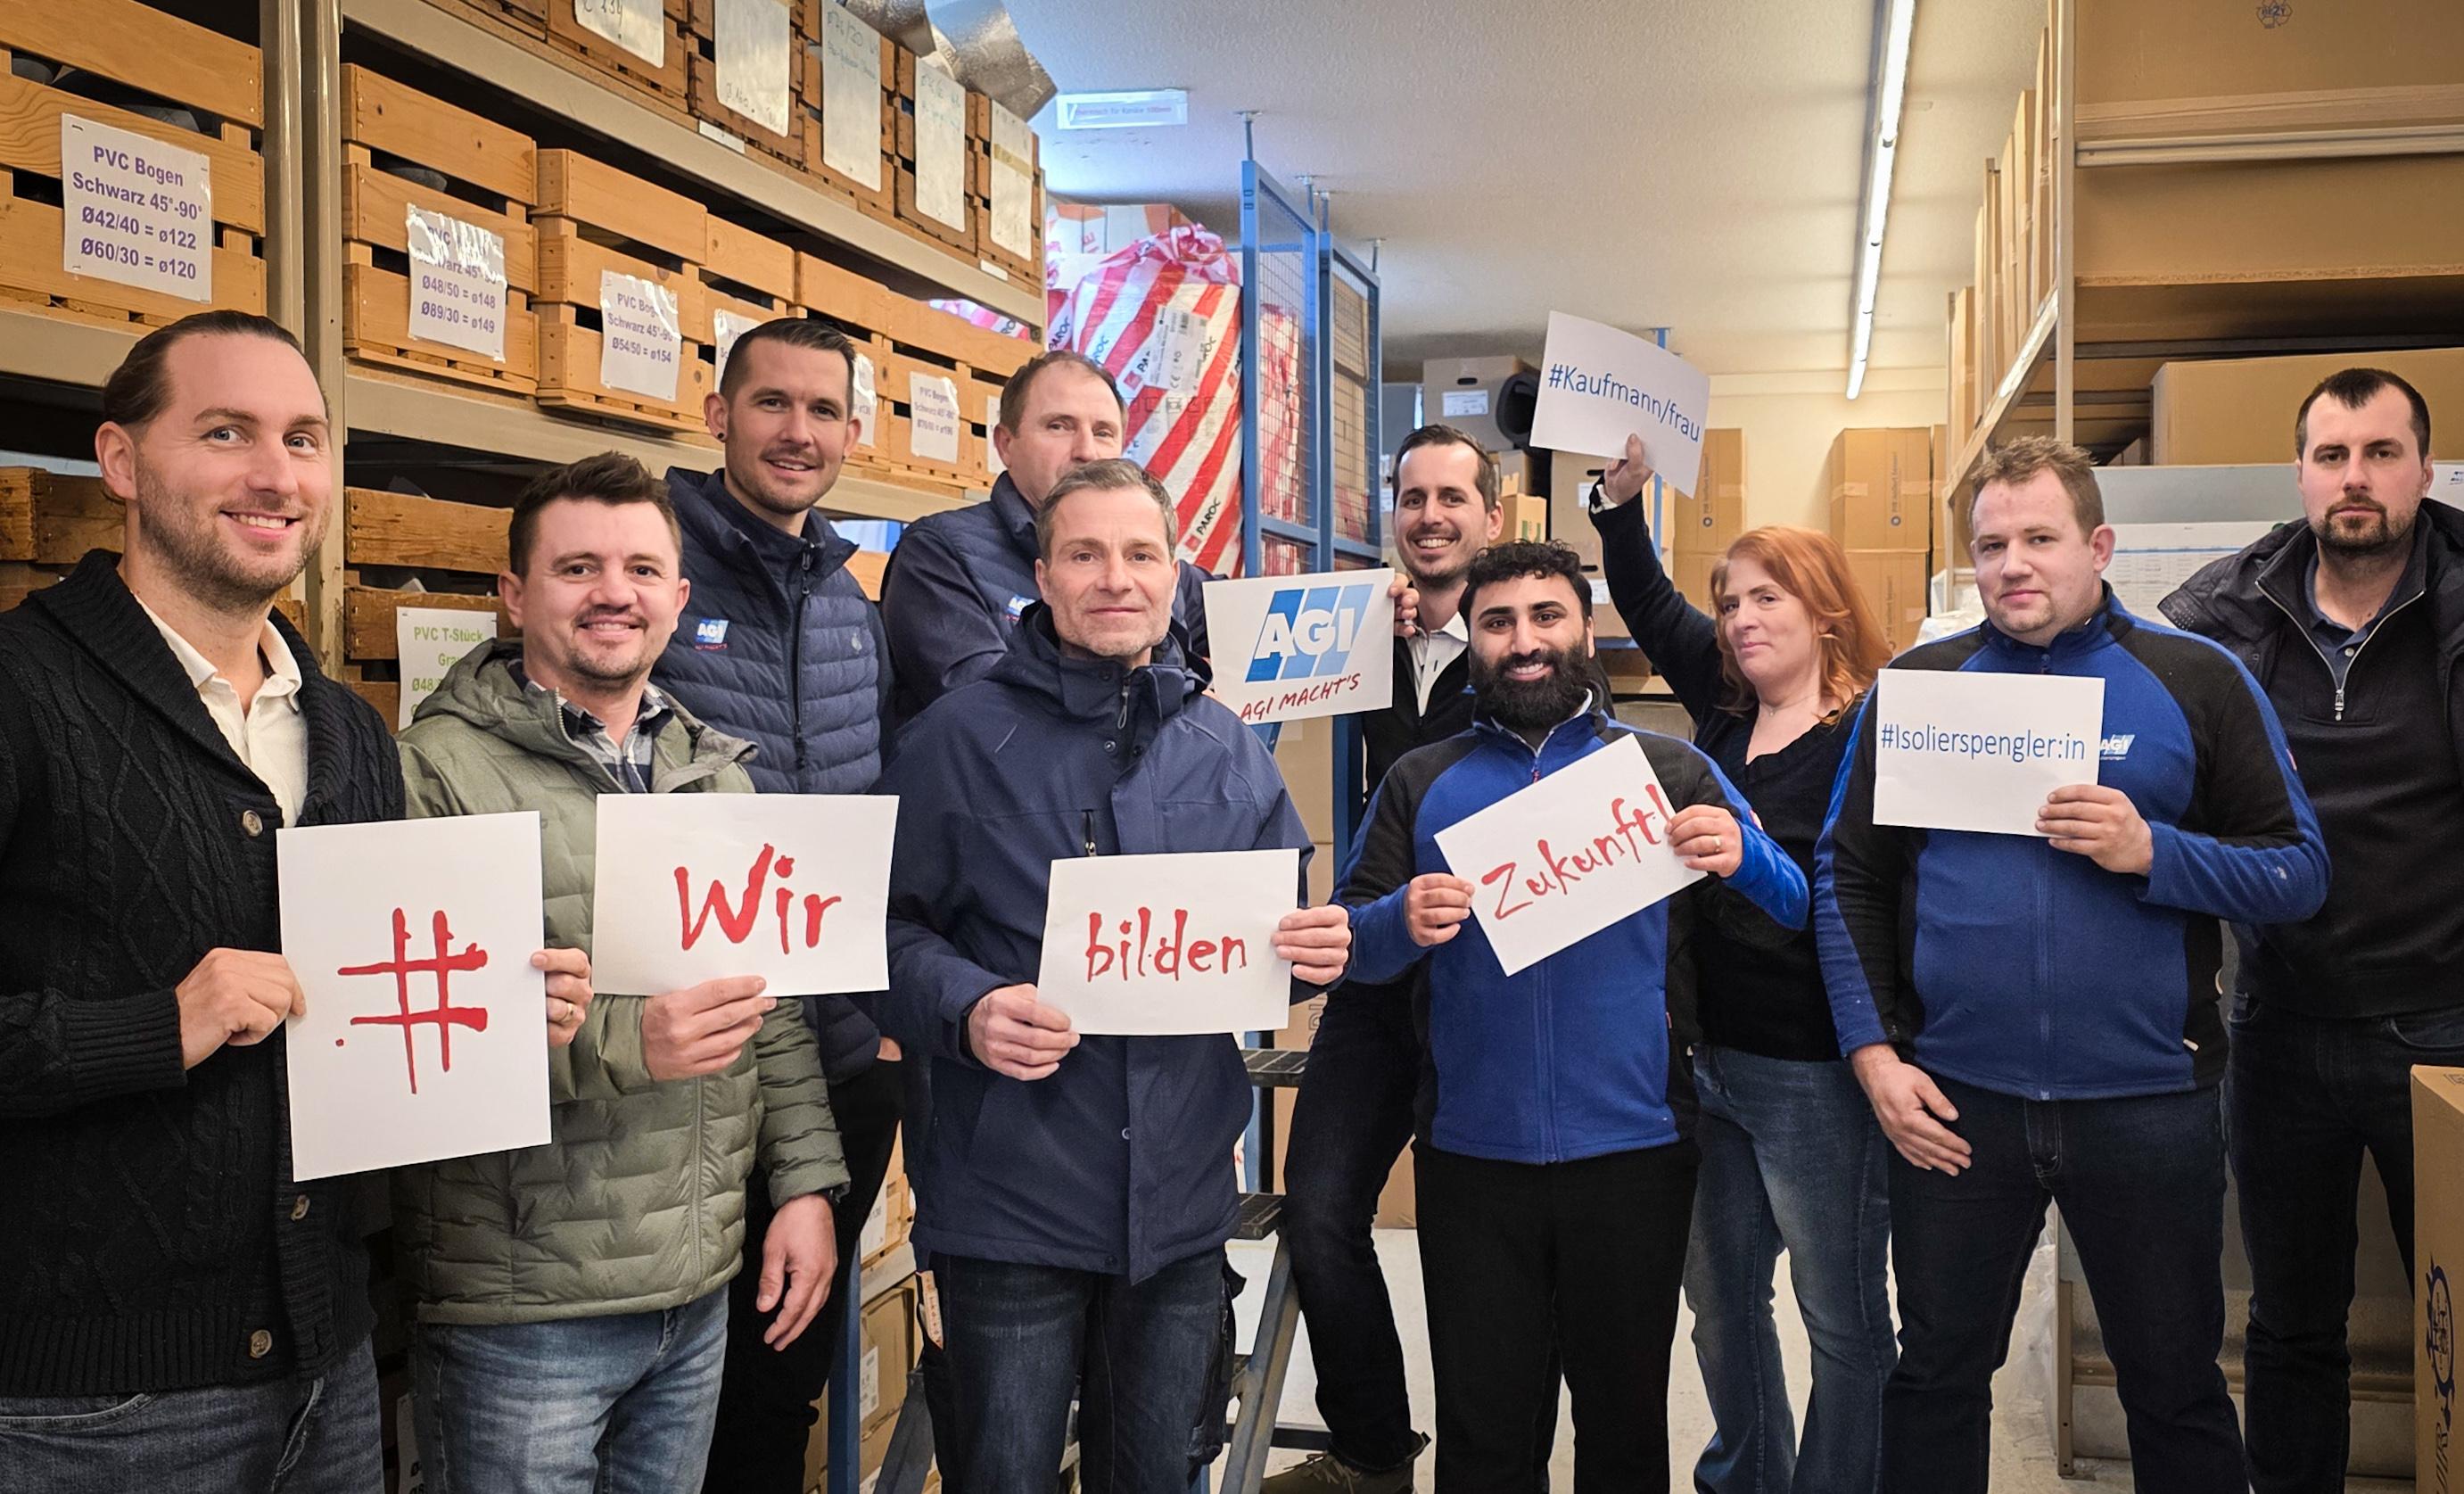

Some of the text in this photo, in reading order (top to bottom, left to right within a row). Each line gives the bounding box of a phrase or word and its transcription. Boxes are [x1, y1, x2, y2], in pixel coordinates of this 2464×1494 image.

[94, 145, 184, 186] PVC Bogen
[72, 171, 202, 220] Schwarz 45°-90°
[81, 206, 197, 251] Ø42/40 = ø122
[80, 237, 197, 280] Ø60/30 = ø120
[422, 275, 459, 299] Ø48/50
[617, 293, 637, 310] PVC
[421, 301, 459, 324] Ø89/30
[607, 312, 645, 335] Schwarz
[612, 336, 642, 356] Ø54/50
[1048, 315, 1071, 351] PAROC
[1548, 363, 1701, 443] #Kaufmann/frau
[1196, 497, 1222, 536] PAROC
[414, 626, 483, 642] PVC T-Stück
[438, 652, 460, 667] Gra
[1240, 673, 1361, 721] AGI MACHT'S
[1881, 723, 2086, 763] #Isolierspengler:in
[1481, 783, 1672, 920] Zukunft!
[674, 843, 842, 955] Wir
[1085, 906, 1248, 983] bilden
[335, 907, 488, 1095] #
